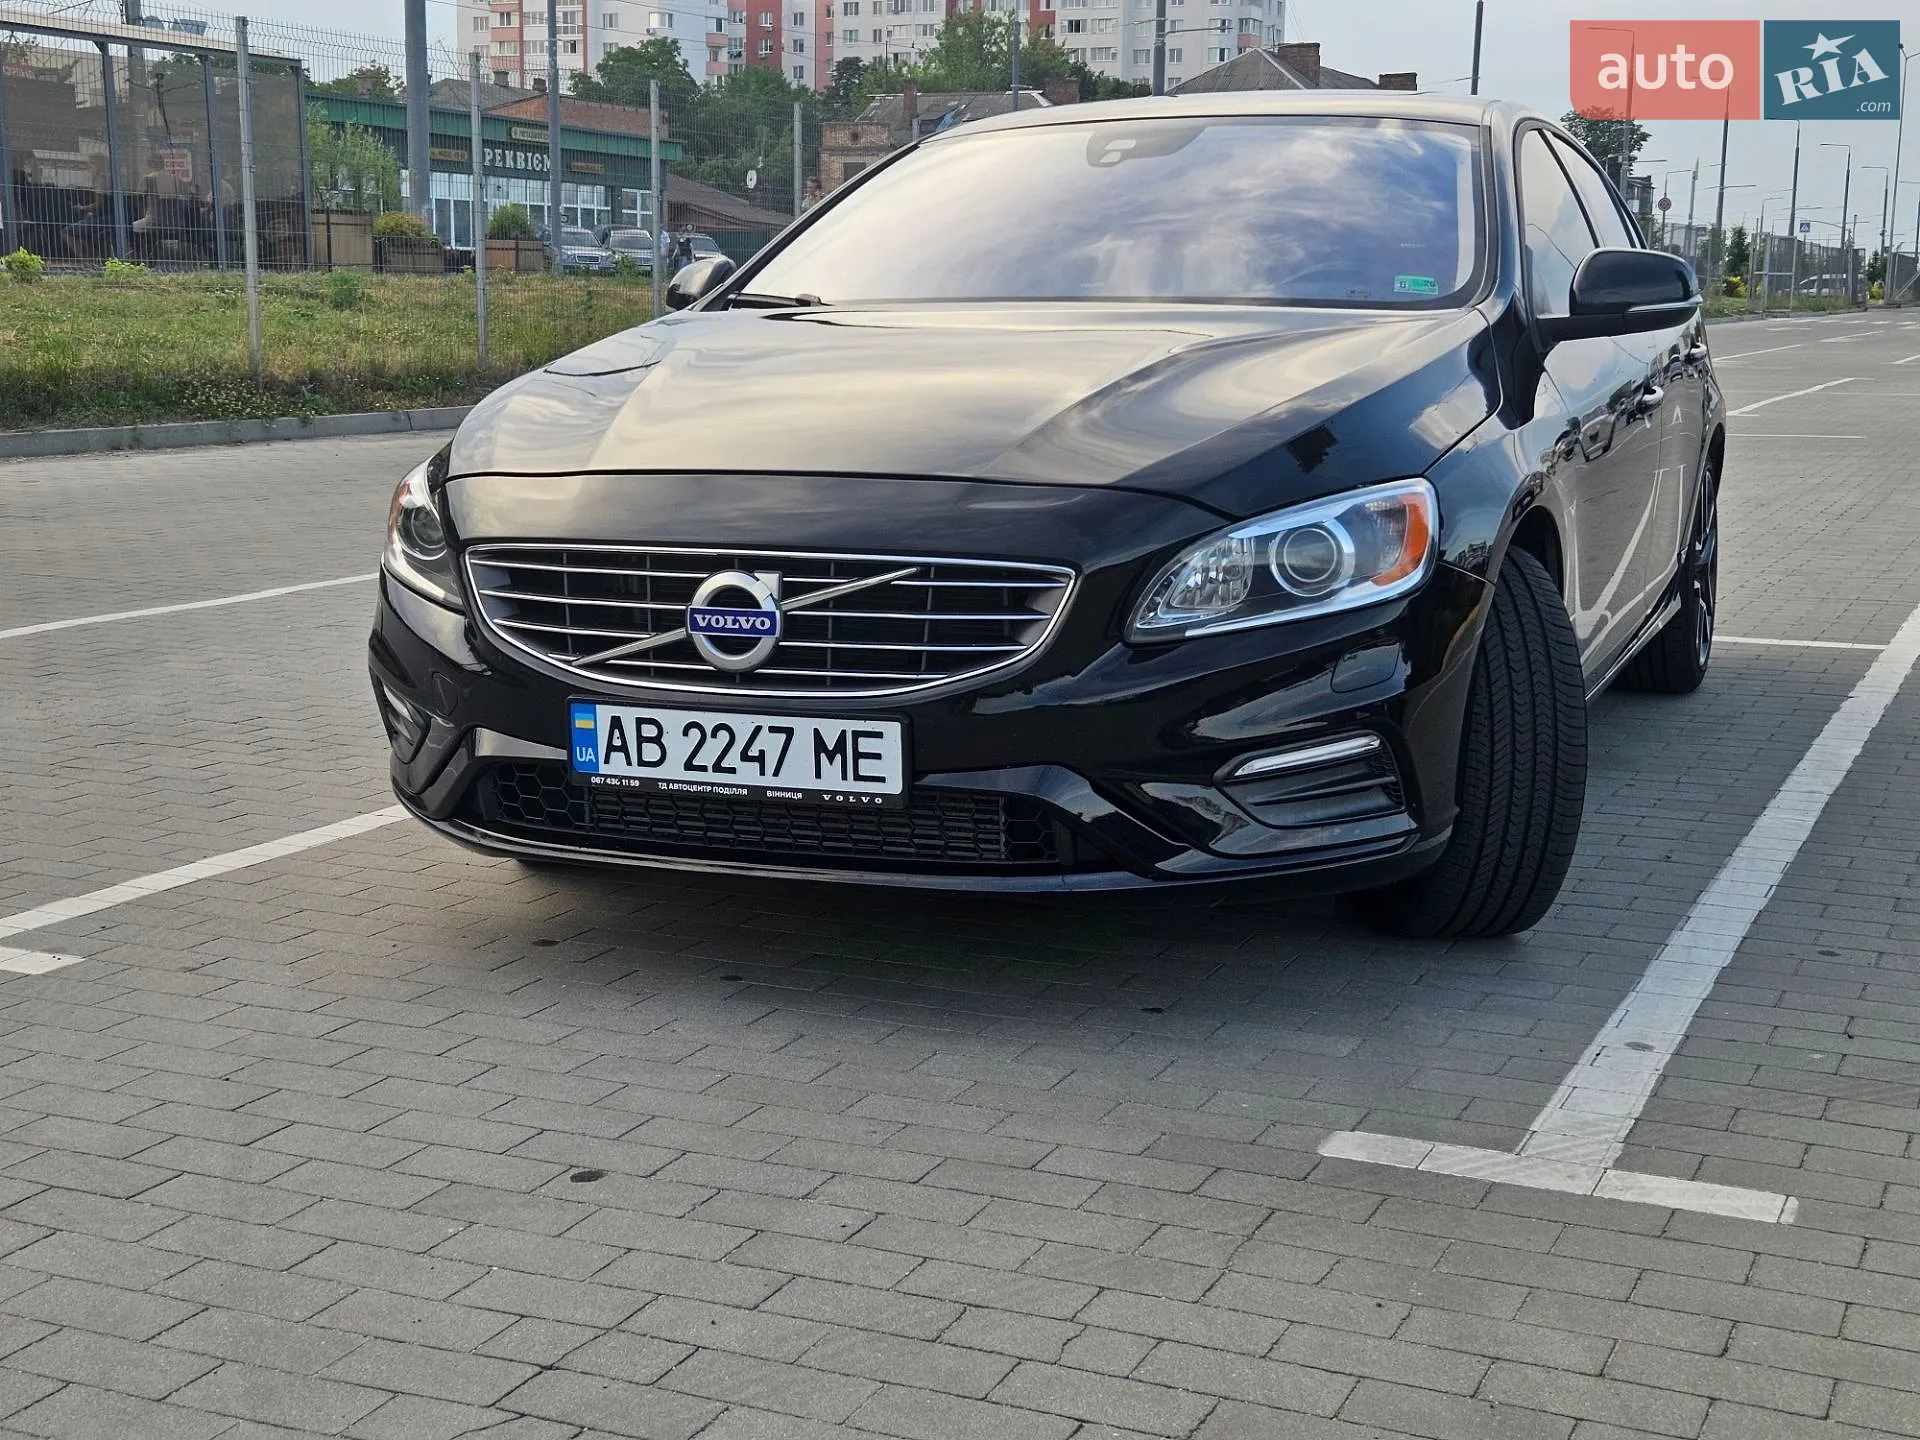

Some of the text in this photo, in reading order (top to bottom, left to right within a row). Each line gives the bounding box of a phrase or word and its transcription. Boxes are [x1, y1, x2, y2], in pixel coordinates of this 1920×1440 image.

[694, 614, 771, 630] VOLVO
[576, 746, 597, 763] UA
[603, 715, 887, 783] AB 2247 ME
[591, 776, 605, 785] 067
[621, 779, 630, 787] 11
[658, 782, 748, 796] ТД АВТОЦЕНТР ПОДІЛЛЯ
[766, 790, 803, 800] ВІННИЦЯ
[822, 794, 883, 805] VOLVO
